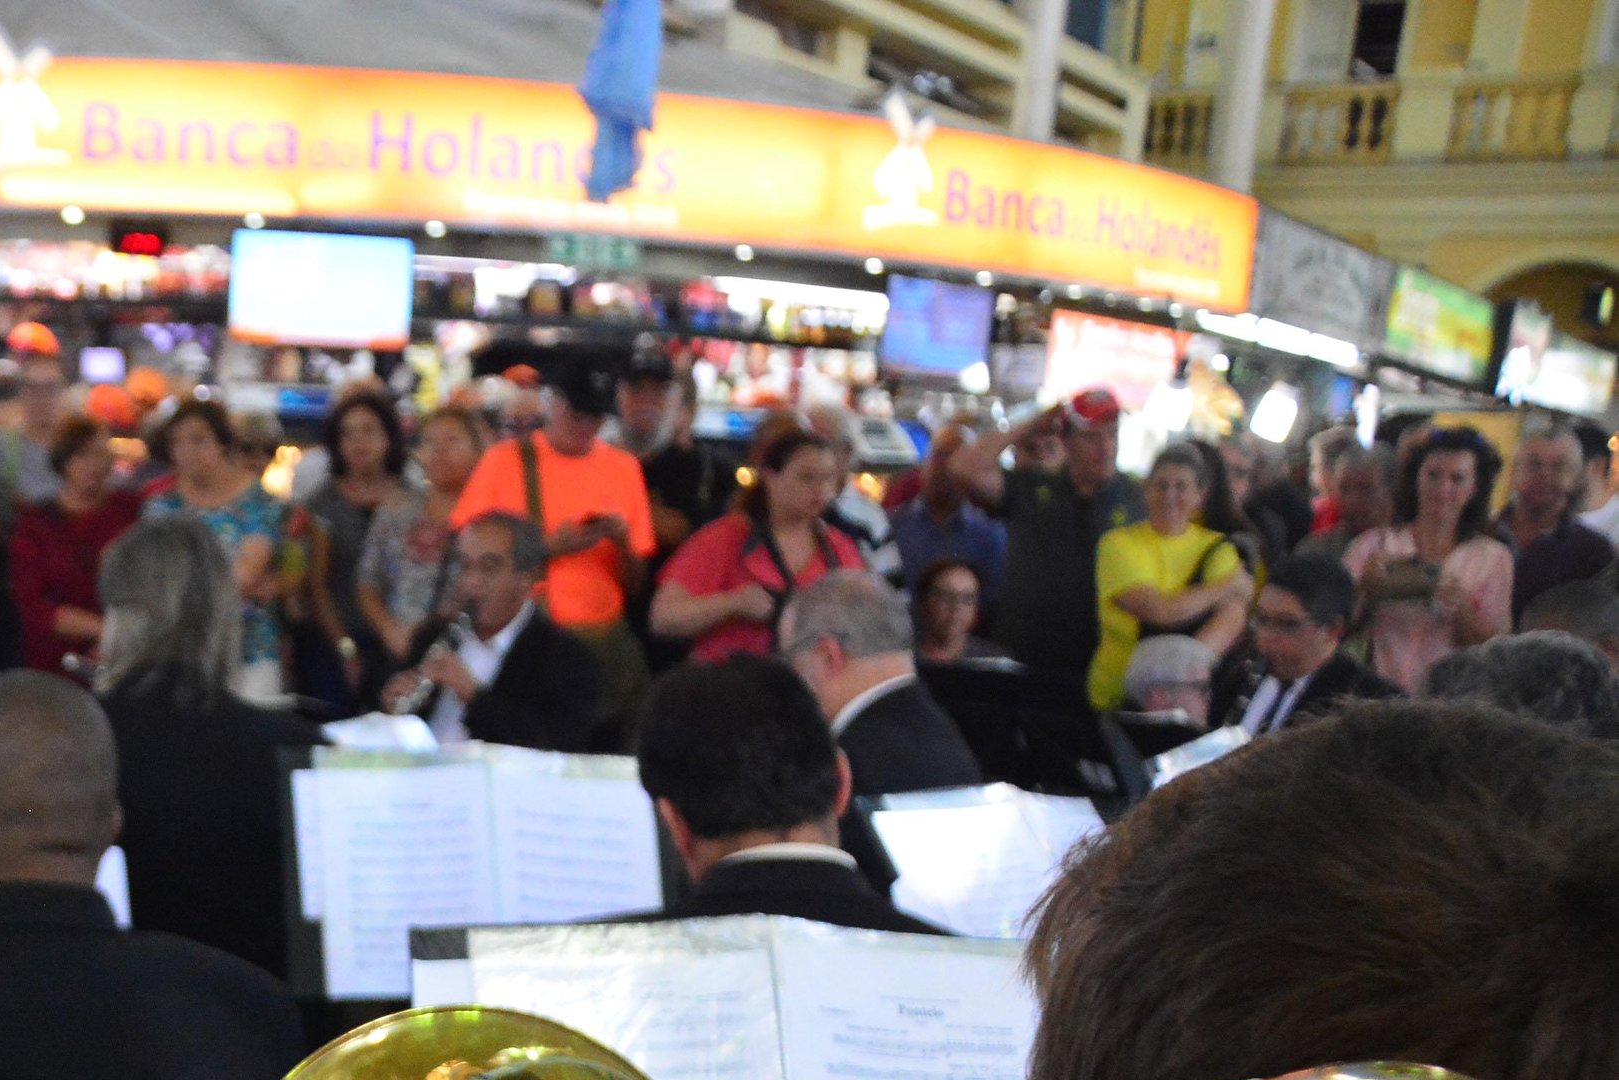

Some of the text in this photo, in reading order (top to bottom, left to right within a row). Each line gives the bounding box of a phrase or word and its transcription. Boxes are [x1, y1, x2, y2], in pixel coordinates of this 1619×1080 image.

[81, 99, 299, 168] Banca
[369, 109, 677, 194] Holans
[944, 168, 1066, 236] Banca
[1096, 193, 1221, 270] Holandês
